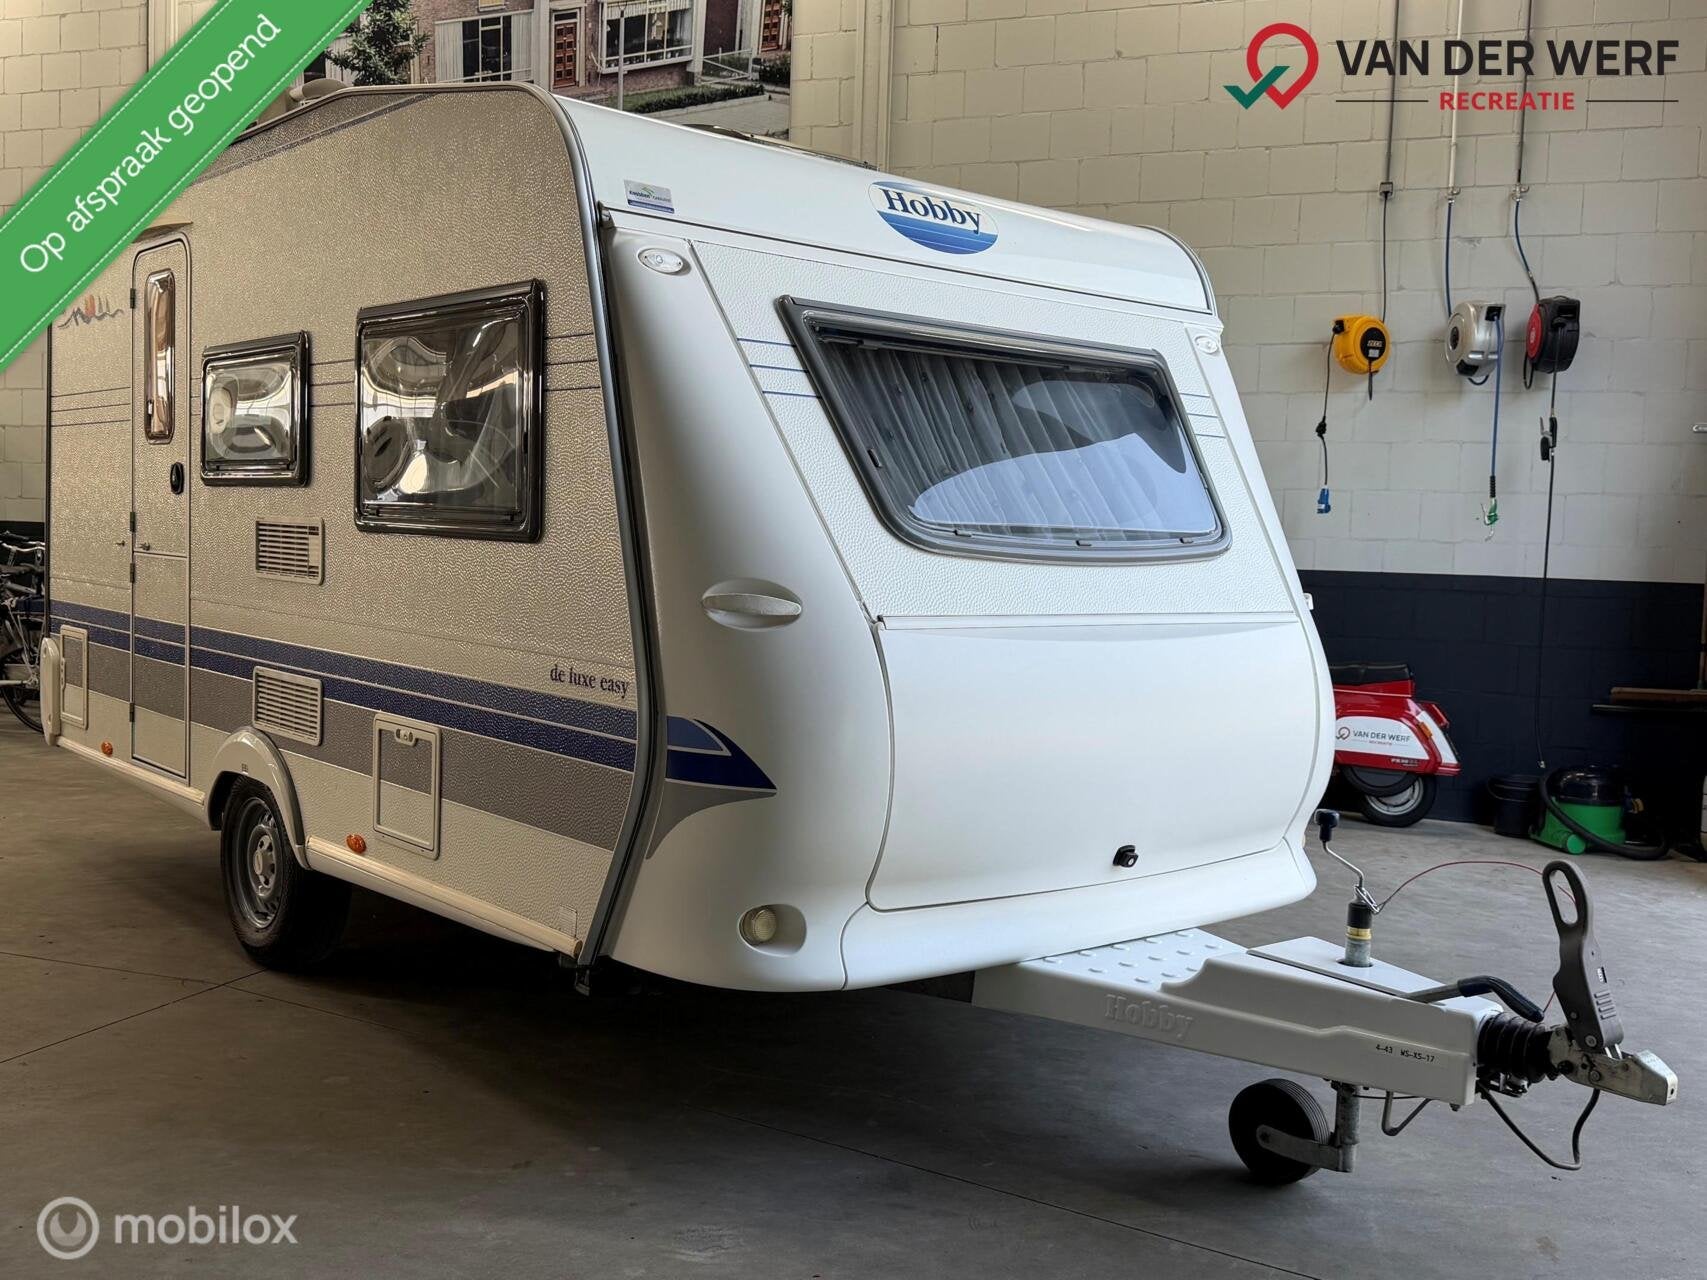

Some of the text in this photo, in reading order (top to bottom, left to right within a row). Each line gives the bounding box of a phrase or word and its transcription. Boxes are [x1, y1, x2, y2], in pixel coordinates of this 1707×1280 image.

[879, 187, 981, 235] Hobby
[550, 664, 629, 699] de luxe easy
[1353, 730, 1411, 742] VAN DER WERF
[1104, 994, 1193, 1038] Hobby
